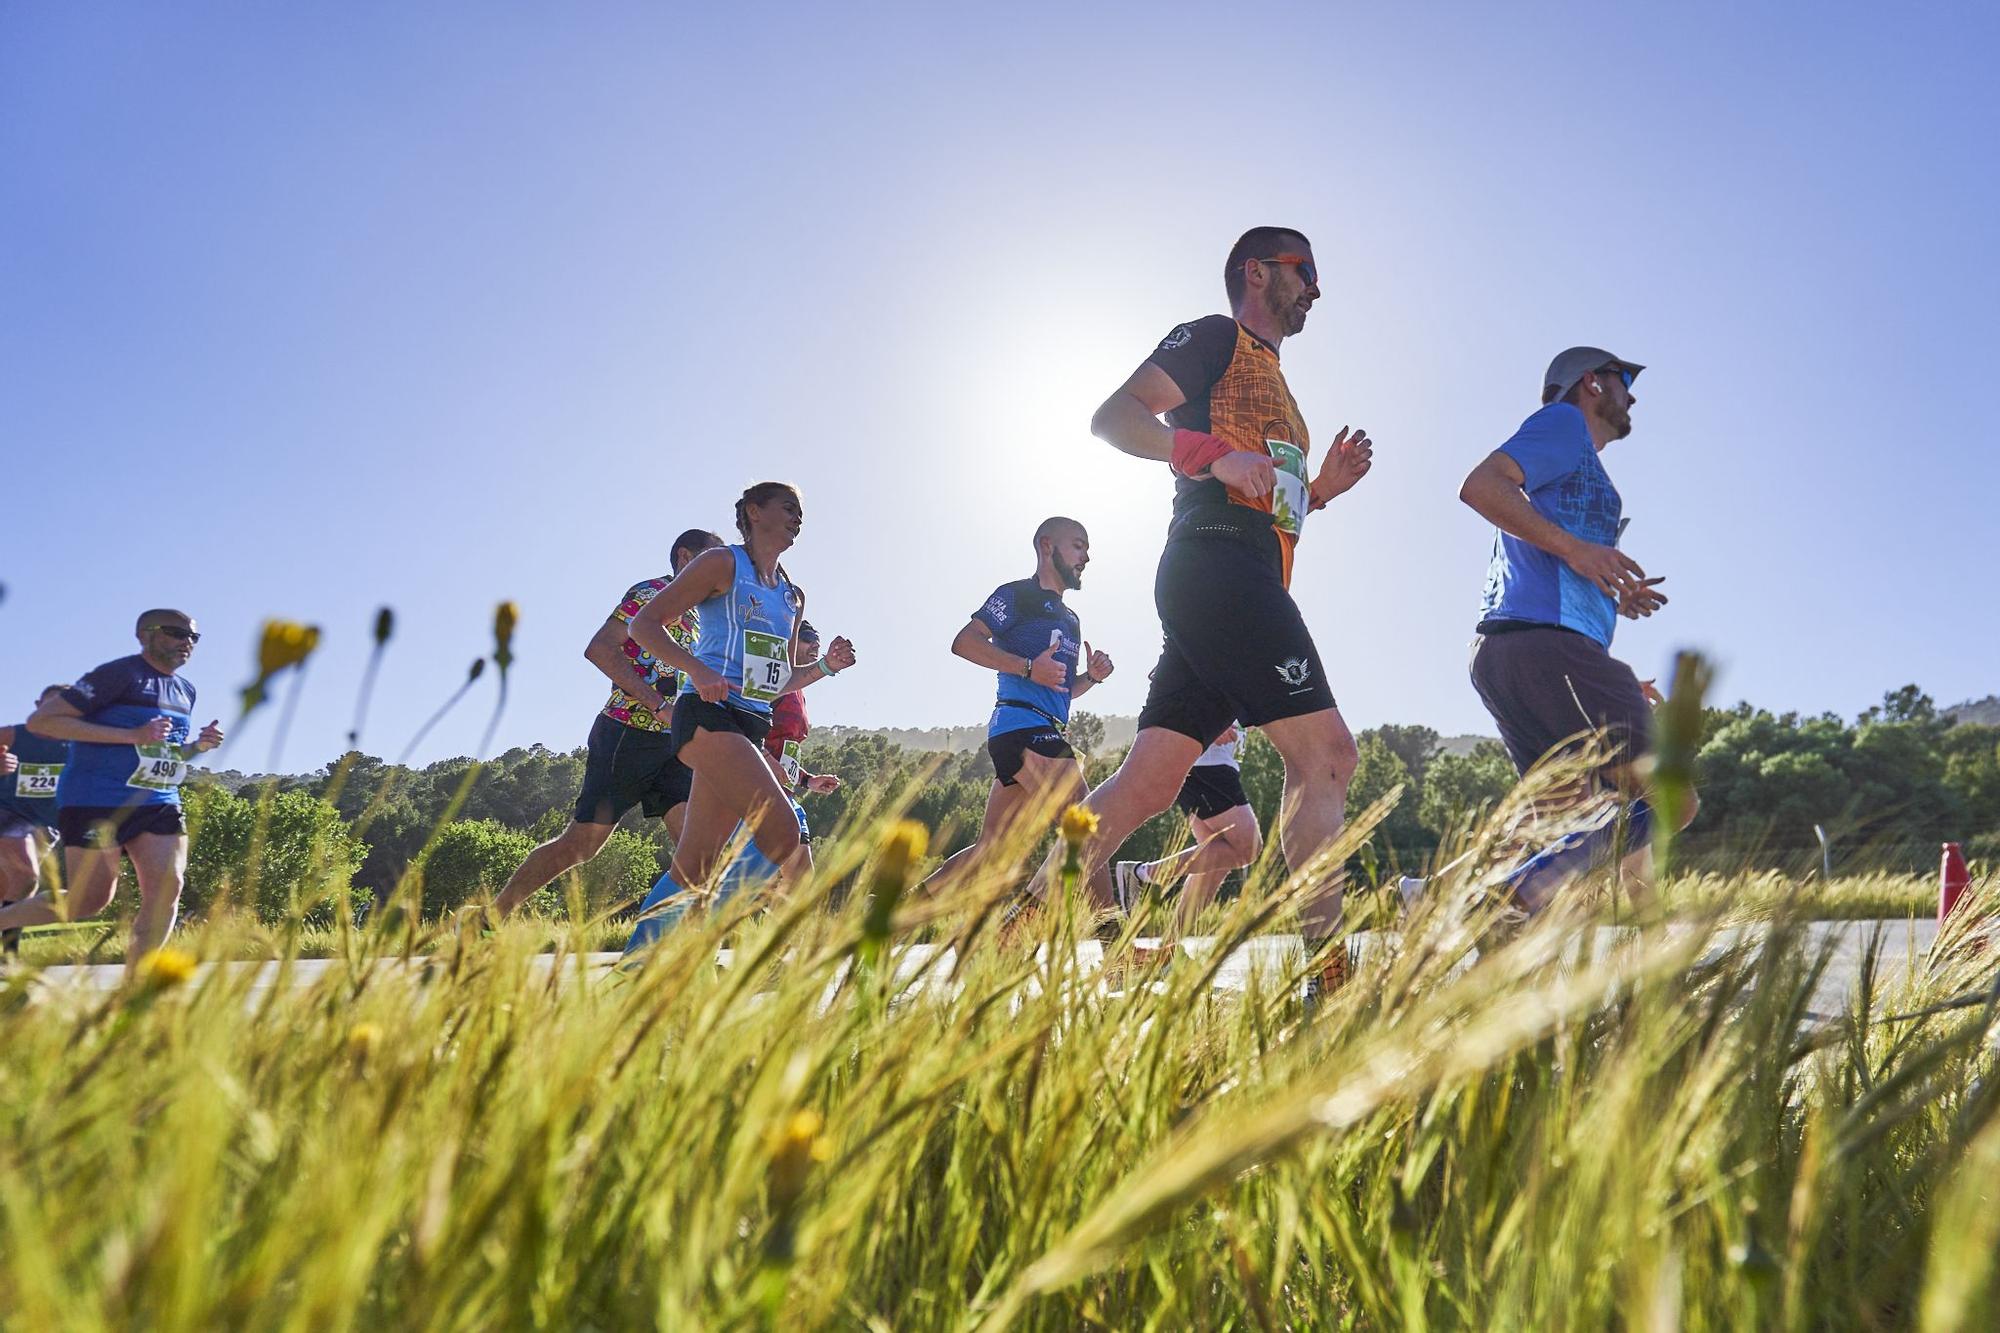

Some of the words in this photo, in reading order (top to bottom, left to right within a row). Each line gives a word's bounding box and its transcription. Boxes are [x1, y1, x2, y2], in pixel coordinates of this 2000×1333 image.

[766, 662, 781, 684] 15
[151, 760, 177, 777] 498
[30, 776, 56, 788] 224
